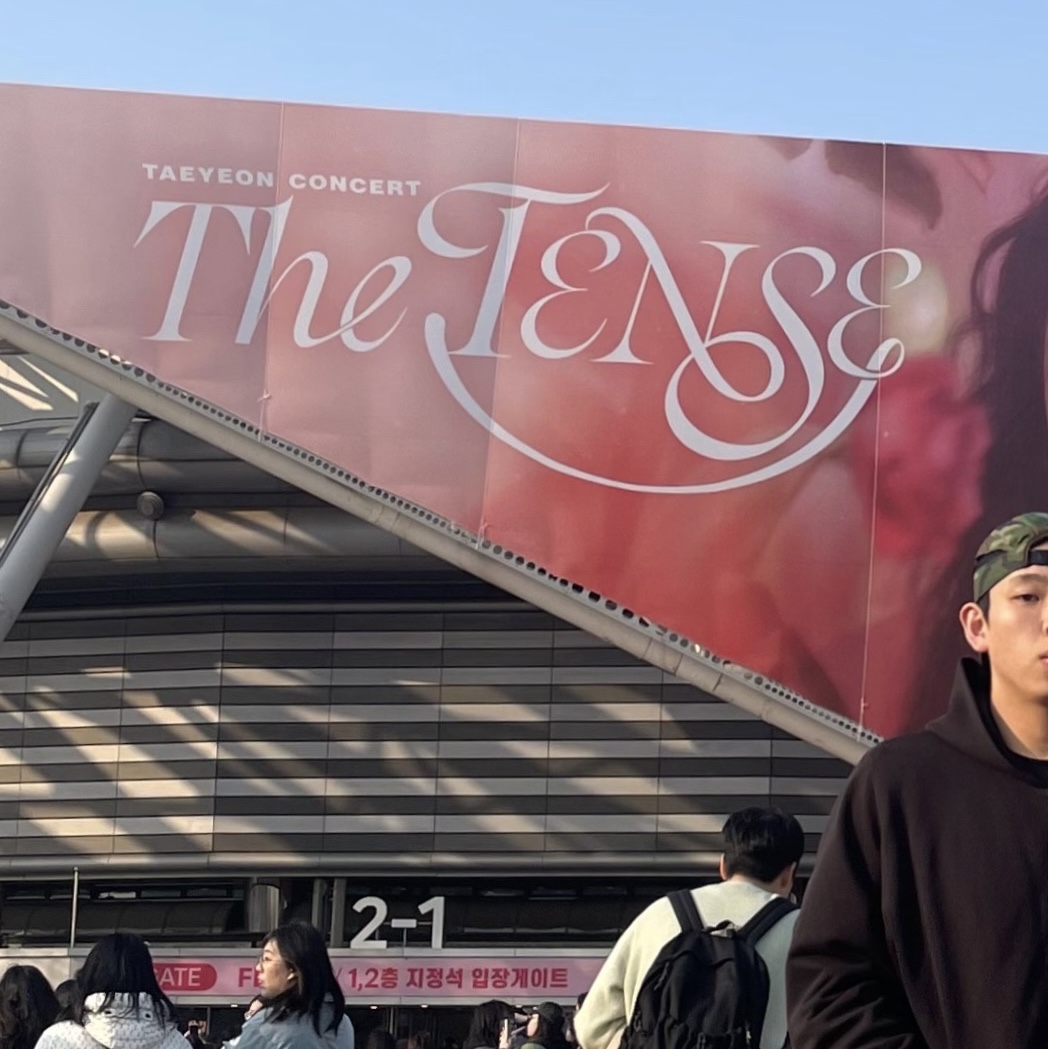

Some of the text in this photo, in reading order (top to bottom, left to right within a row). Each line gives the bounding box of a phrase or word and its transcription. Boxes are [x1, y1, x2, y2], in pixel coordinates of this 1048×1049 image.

[142, 163, 421, 196] TAEYEON CONCERT
[133, 182, 922, 494] The TENSE
[350, 896, 445, 949] 2-1
[348, 967, 399, 991] 1,2층
[406, 967, 465, 989] 지정석
[471, 967, 569, 989] 입장게이트
